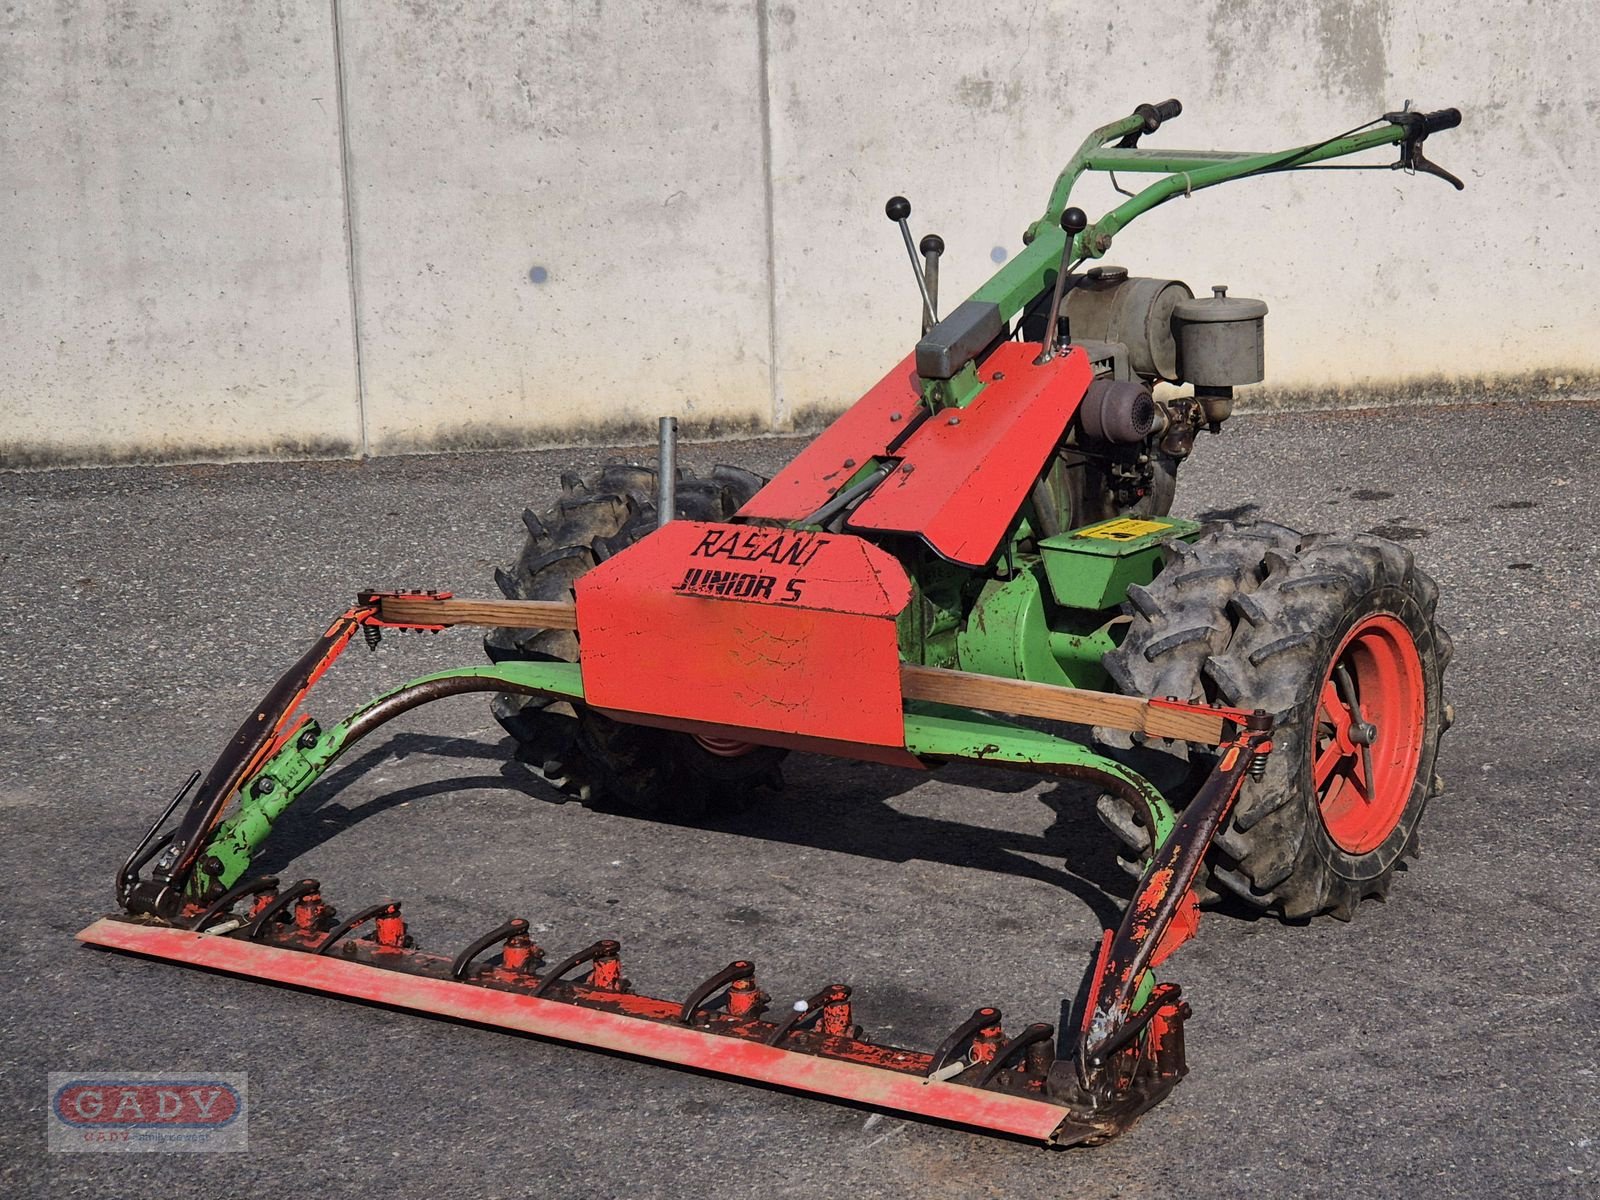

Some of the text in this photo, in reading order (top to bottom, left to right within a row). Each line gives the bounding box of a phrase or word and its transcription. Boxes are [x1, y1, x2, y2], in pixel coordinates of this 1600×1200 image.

[691, 530, 830, 566] RASANT
[672, 568, 806, 602] JUNIOR S
